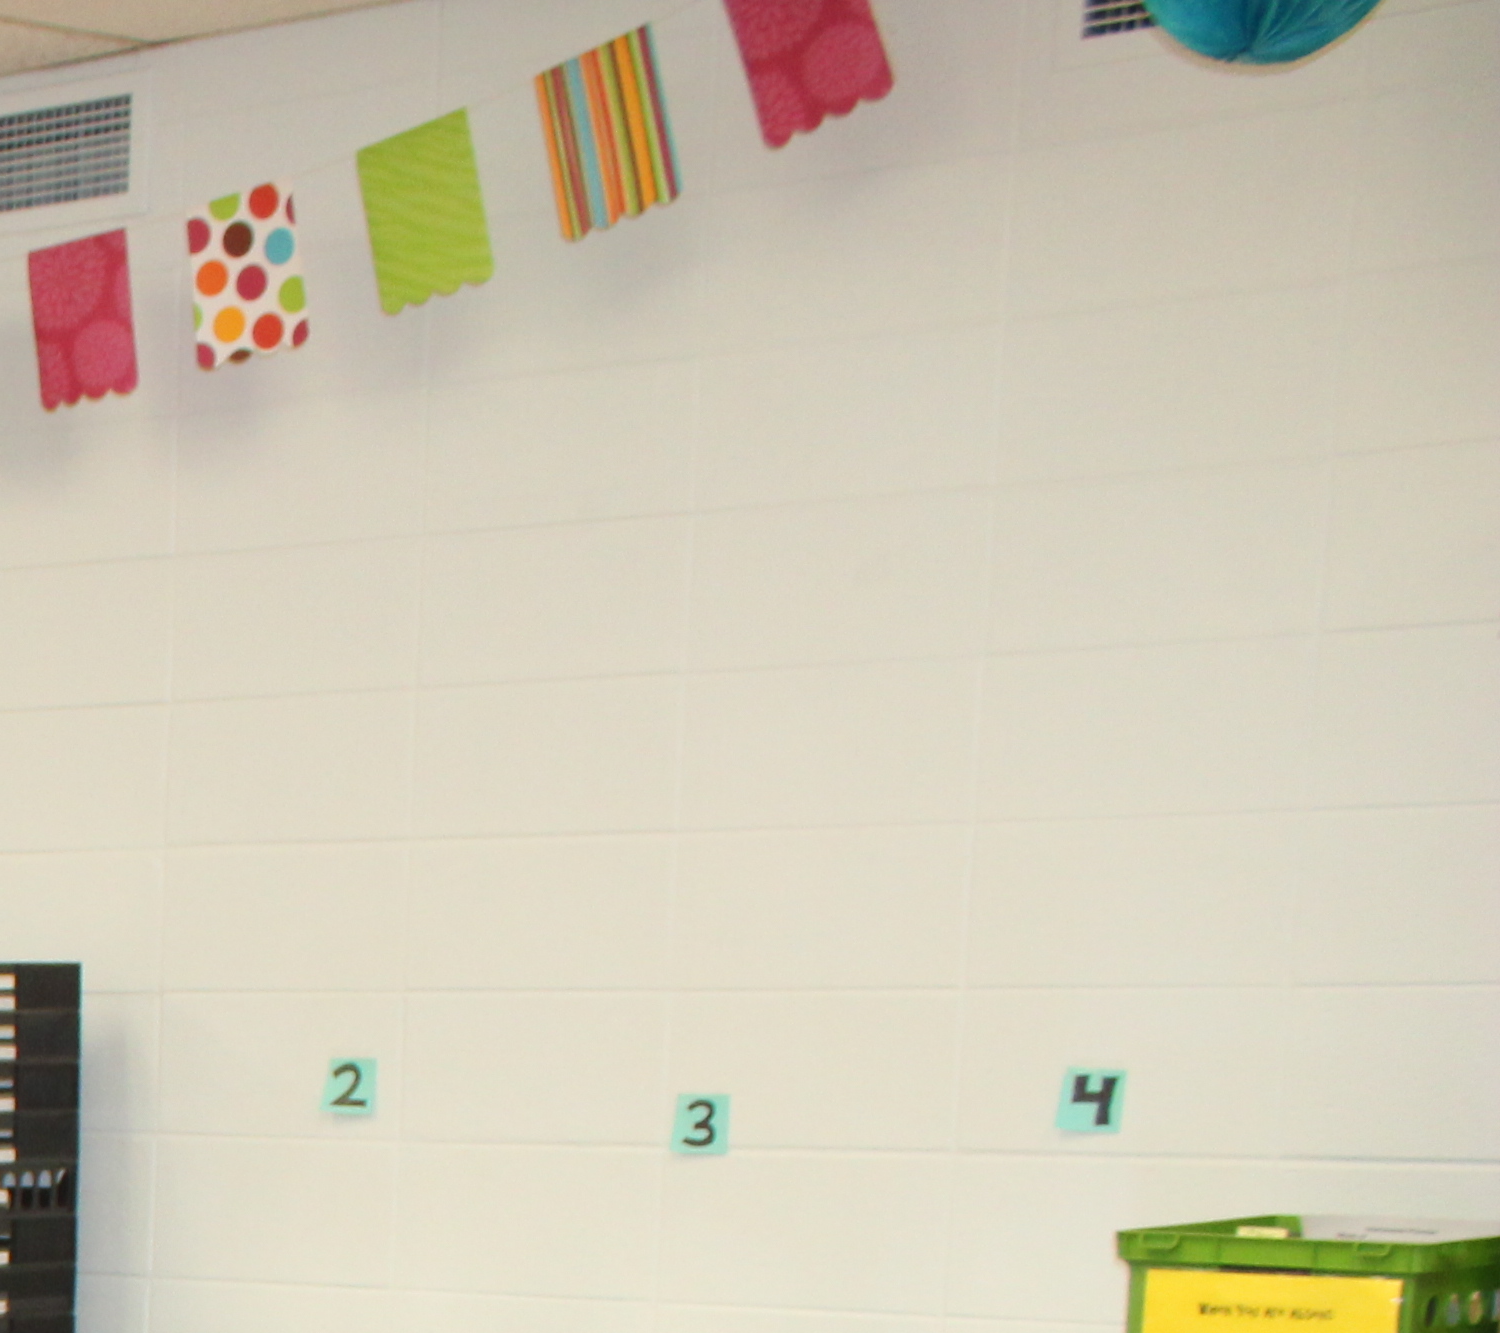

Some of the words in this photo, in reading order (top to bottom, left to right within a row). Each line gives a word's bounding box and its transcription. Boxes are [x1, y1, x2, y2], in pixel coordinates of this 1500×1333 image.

[330, 1062, 367, 1107] 2
[1071, 1075, 1119, 1126] 4
[682, 1099, 717, 1148] 3
